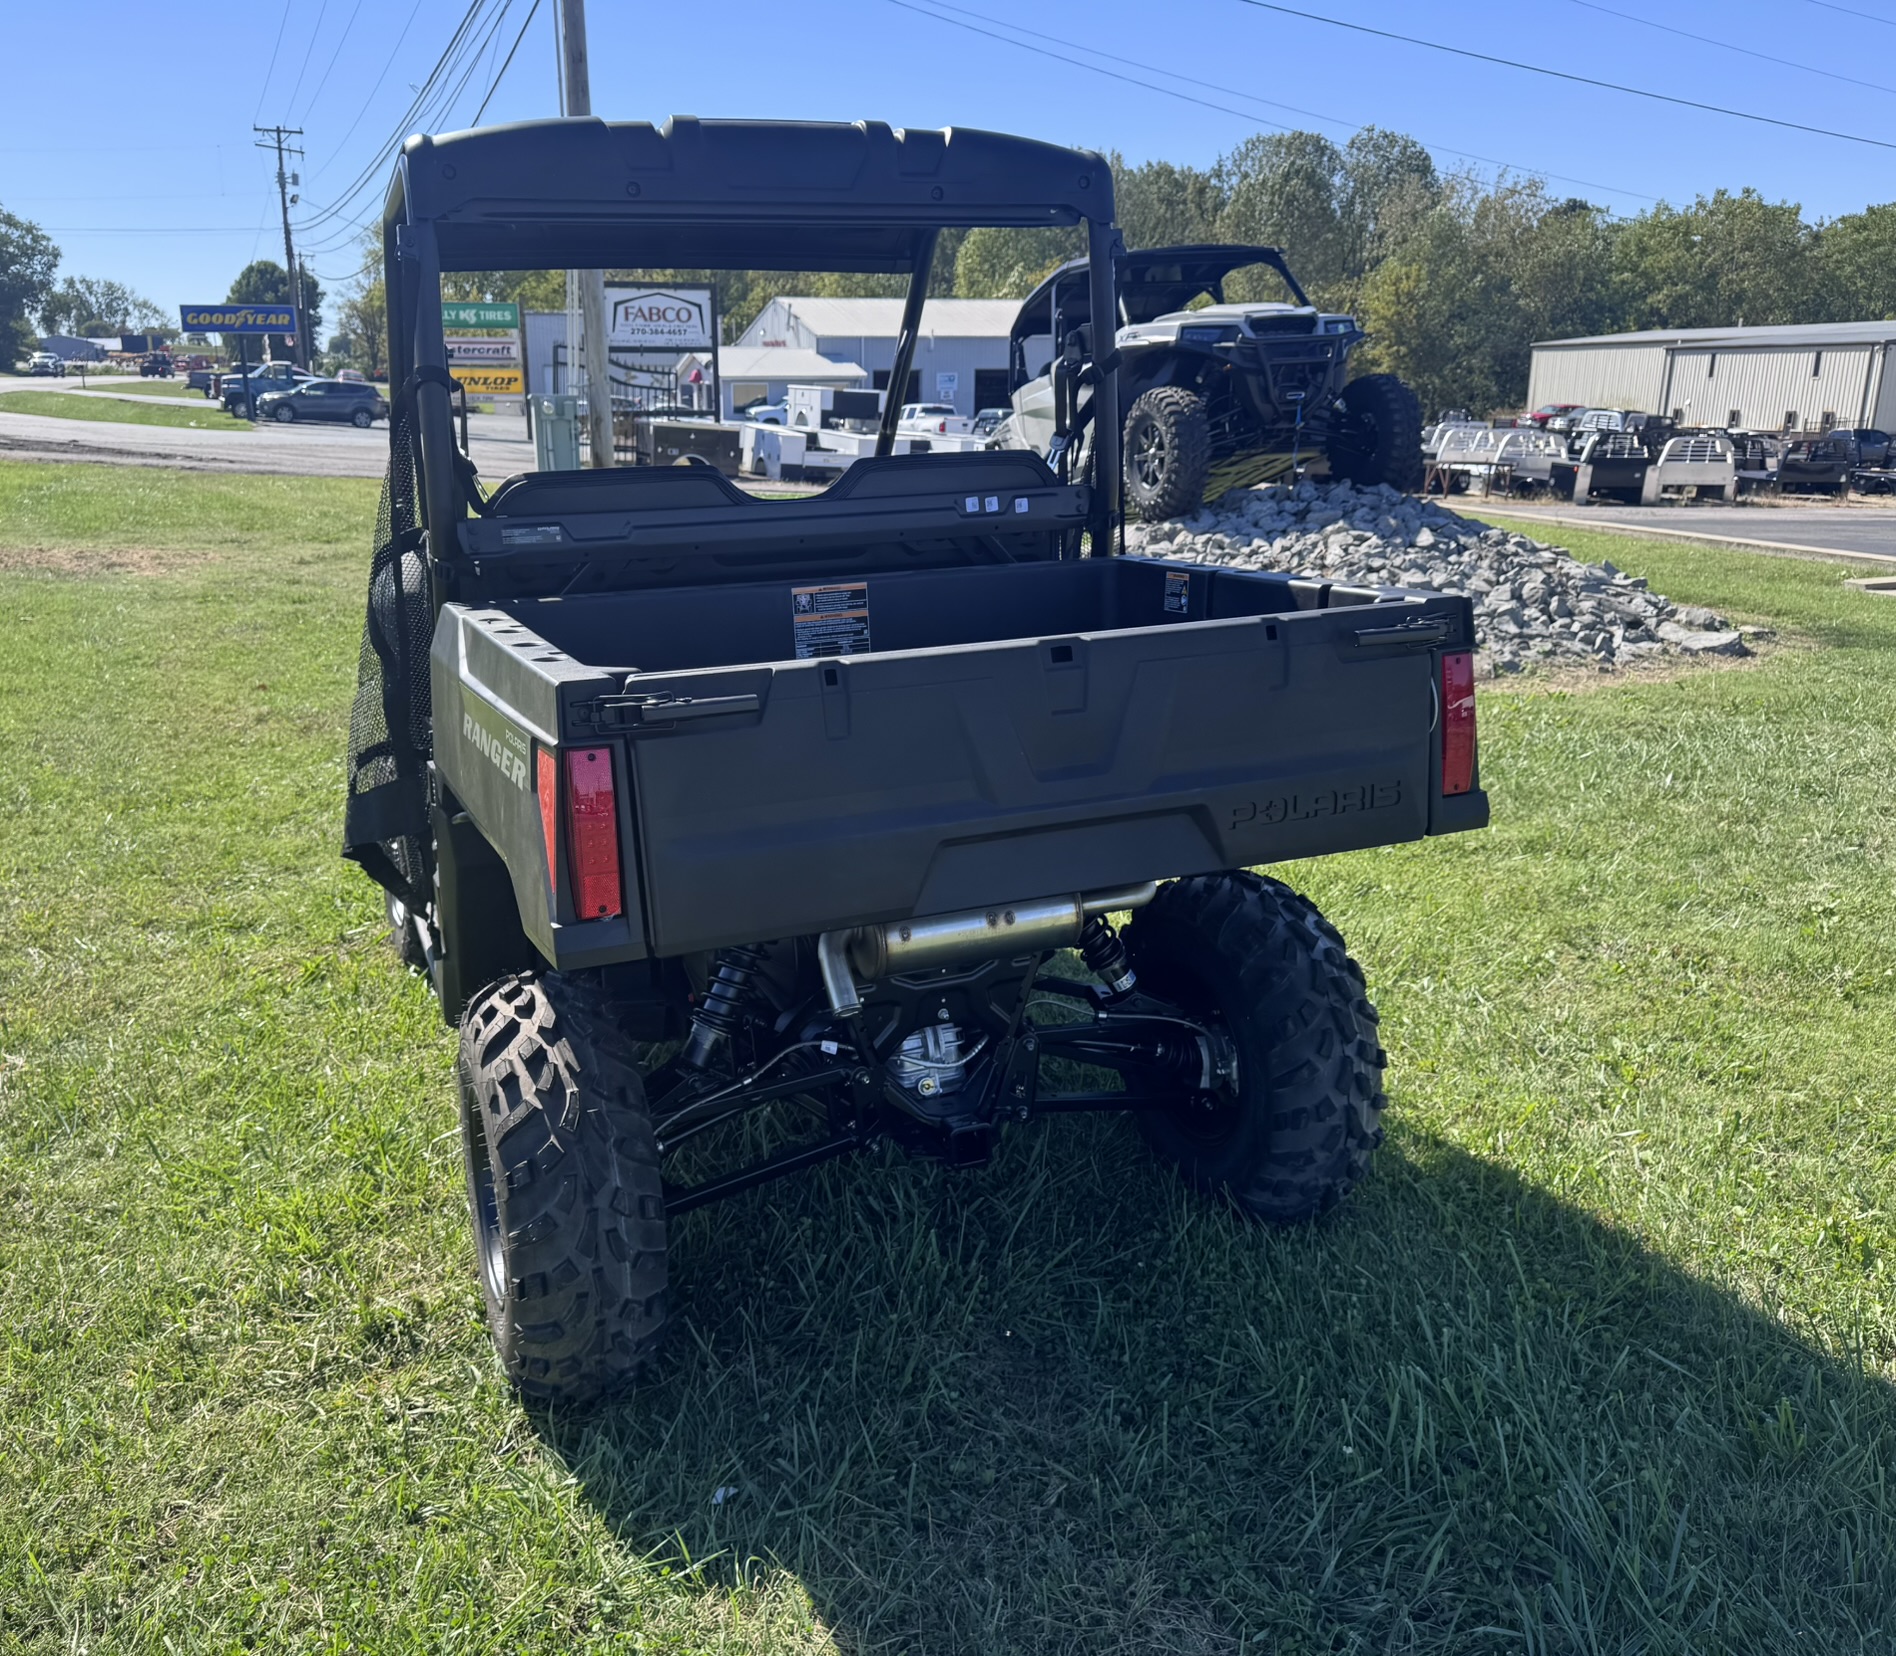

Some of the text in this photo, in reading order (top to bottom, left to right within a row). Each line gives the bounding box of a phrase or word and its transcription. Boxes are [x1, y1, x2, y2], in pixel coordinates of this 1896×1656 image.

[186, 310, 291, 327] GOODYEAR
[479, 311, 511, 321] TIRES
[624, 305, 692, 323] FABCO
[463, 712, 526, 791] RANGER
[1229, 780, 1402, 830] POLARIS
